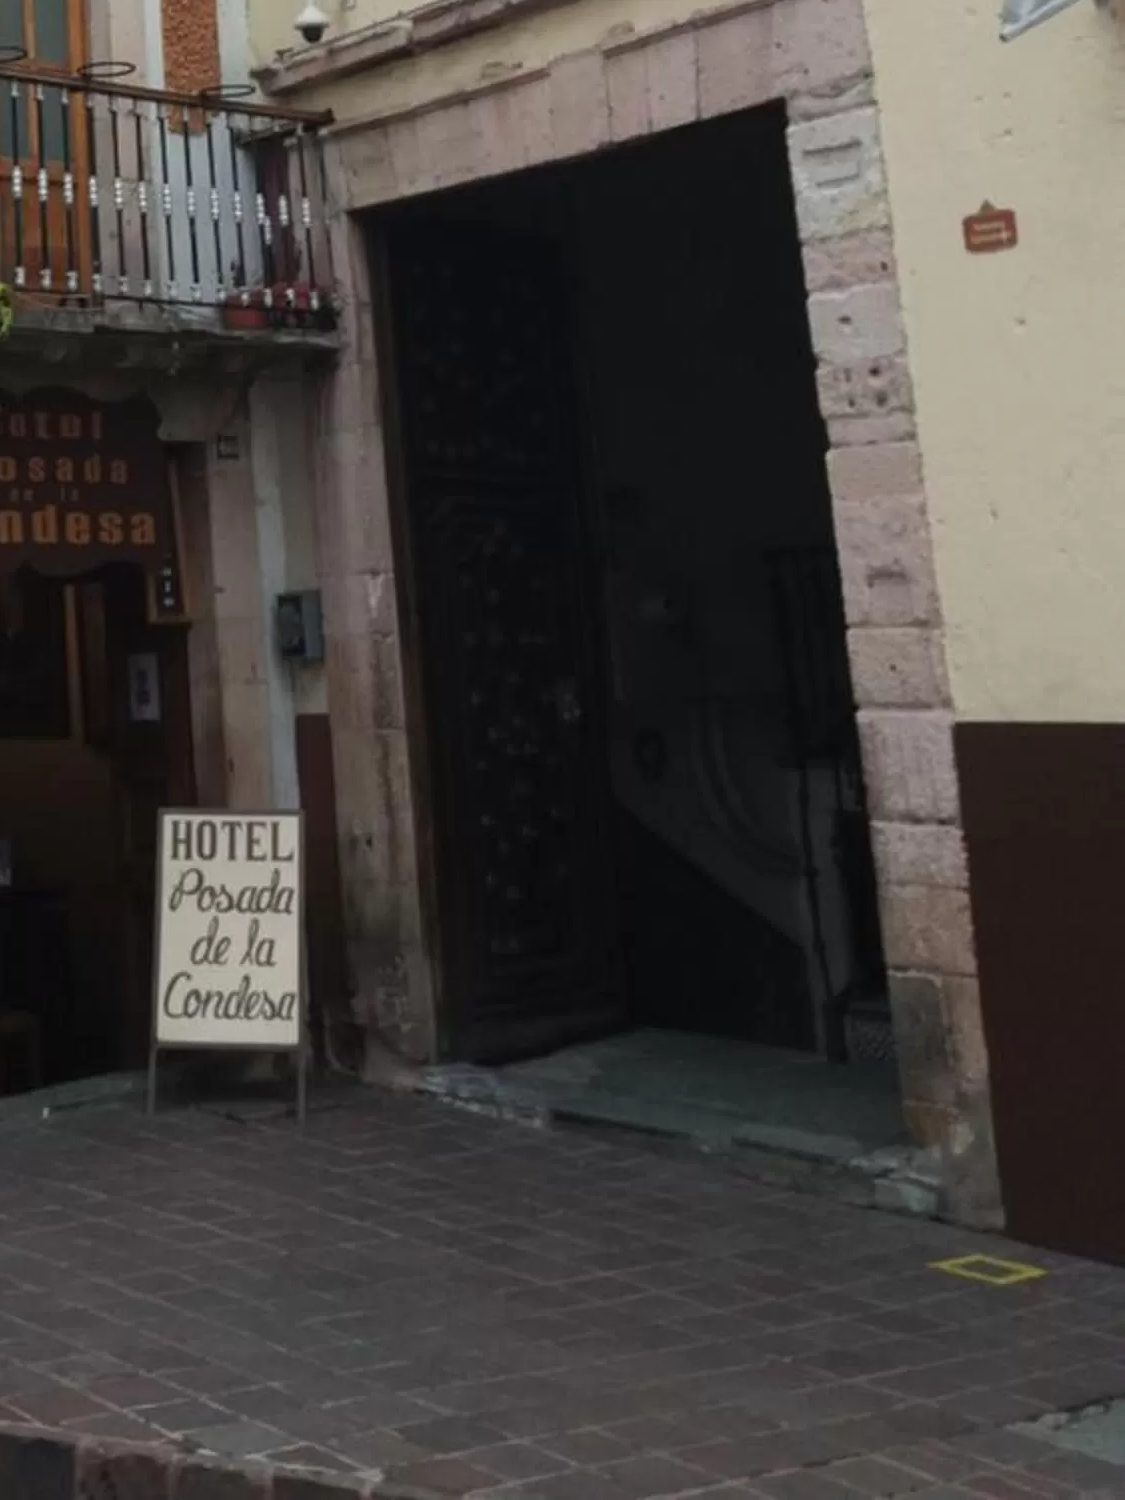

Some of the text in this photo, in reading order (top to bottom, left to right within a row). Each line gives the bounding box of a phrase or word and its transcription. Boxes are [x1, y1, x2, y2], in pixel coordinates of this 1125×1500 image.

[169, 819, 294, 862] HOTEL
[168, 867, 295, 914] Posada
[190, 915, 276, 967] de la
[162, 971, 296, 1021] Condesa
